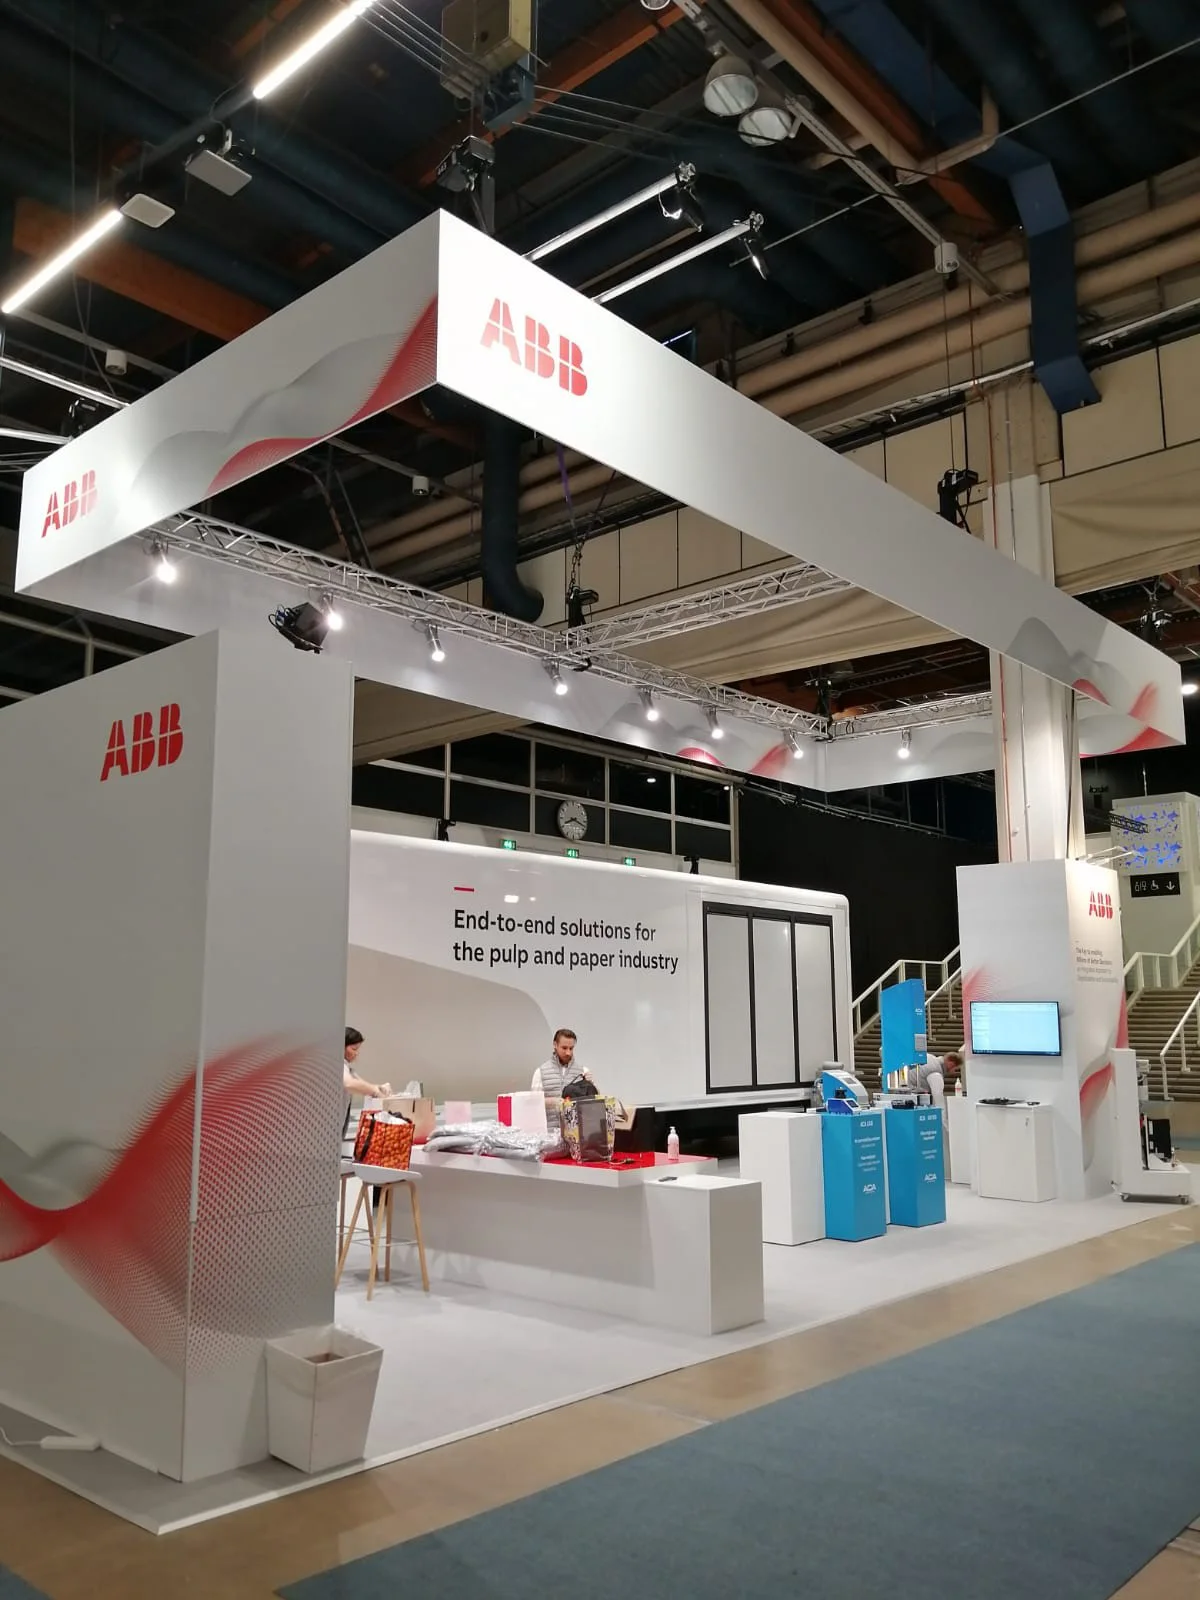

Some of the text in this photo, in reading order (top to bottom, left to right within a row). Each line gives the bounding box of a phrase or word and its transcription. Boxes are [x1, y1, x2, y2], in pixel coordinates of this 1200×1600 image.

[480, 297, 588, 397] ABB
[41, 470, 98, 537] ABB
[101, 703, 184, 782] ABB
[454, 909, 656, 942] End-to-end solutions for
[1089, 892, 1113, 919] ABB
[453, 941, 679, 975] the pulp and paper industry
